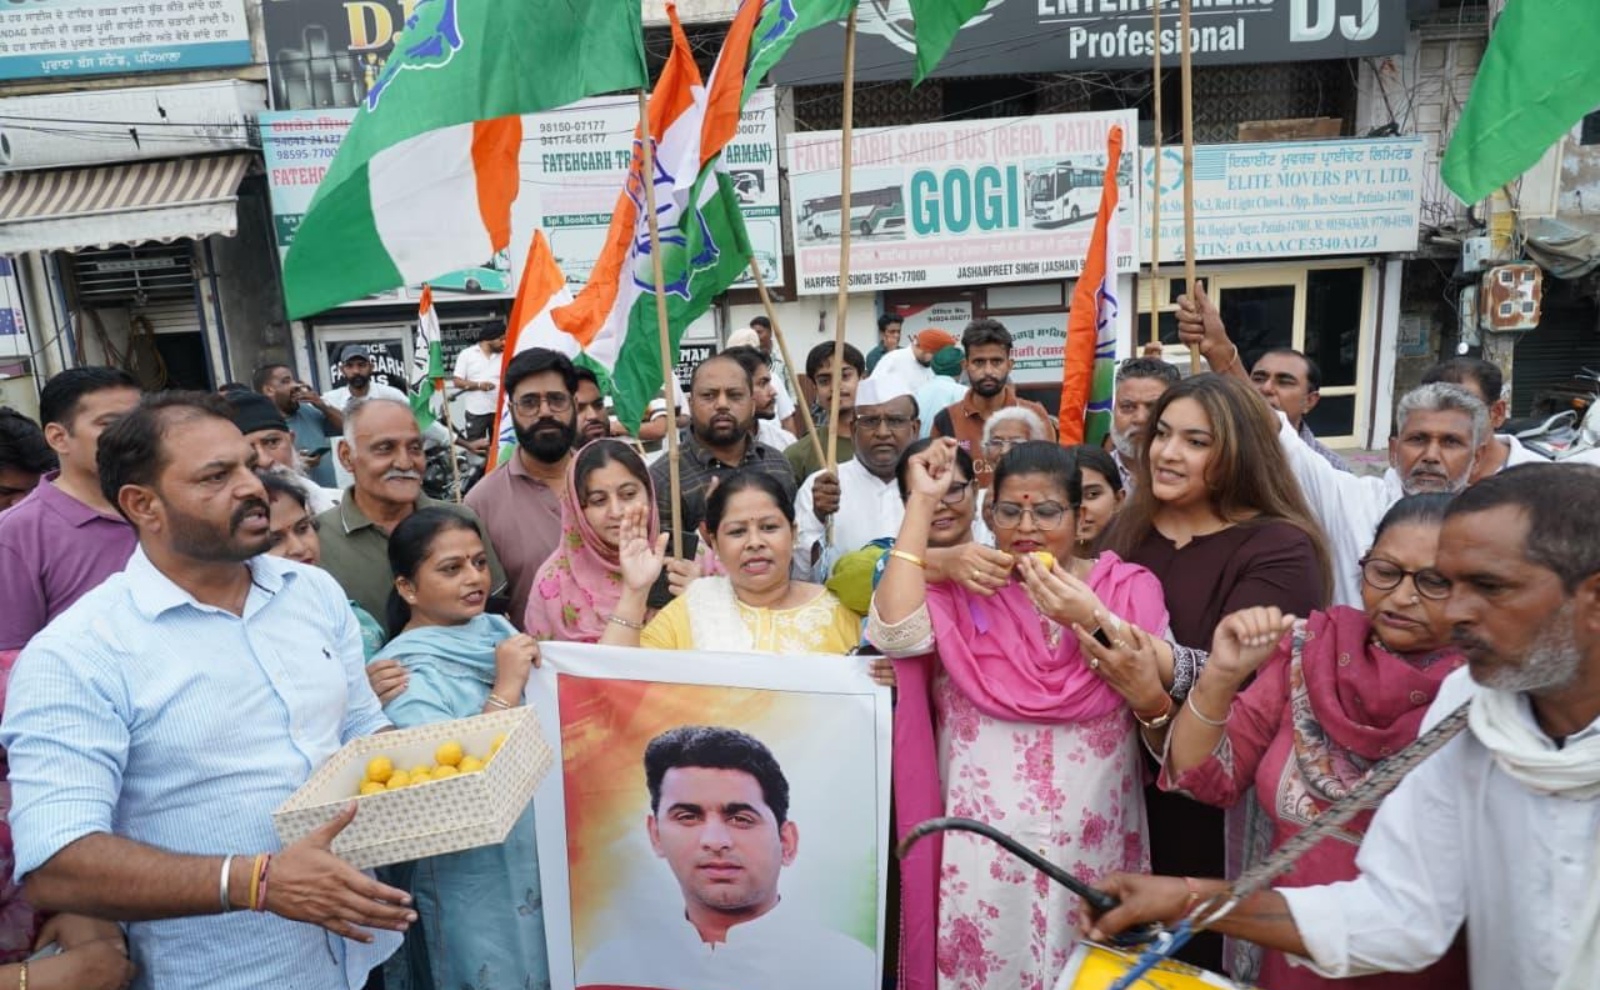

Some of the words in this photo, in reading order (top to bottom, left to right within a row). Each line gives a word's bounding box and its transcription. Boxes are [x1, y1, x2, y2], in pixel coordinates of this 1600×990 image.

[1290, 0, 1380, 42] DJ
[0, 28, 27, 38] NDAG
[1069, 18, 1245, 59] Professional
[276, 148, 340, 160] 98595-7700
[953, 125, 987, 160] BUS
[542, 150, 612, 173] FATEHGARH
[615, 149, 631, 169] TR
[1228, 174, 1272, 190] ELITE
[1278, 170, 1340, 188] MOVERS
[1345, 169, 1376, 186] PVT.
[1380, 168, 1411, 184] LTD.
[911, 165, 1020, 236] GOGI
[957, 264, 1013, 279] JASHANPREET
[1015, 262, 1040, 275] SINGH
[1041, 258, 1078, 275] (JASHAN)
[804, 275, 841, 289] HARPREE
[848, 273, 872, 286] SINGH
